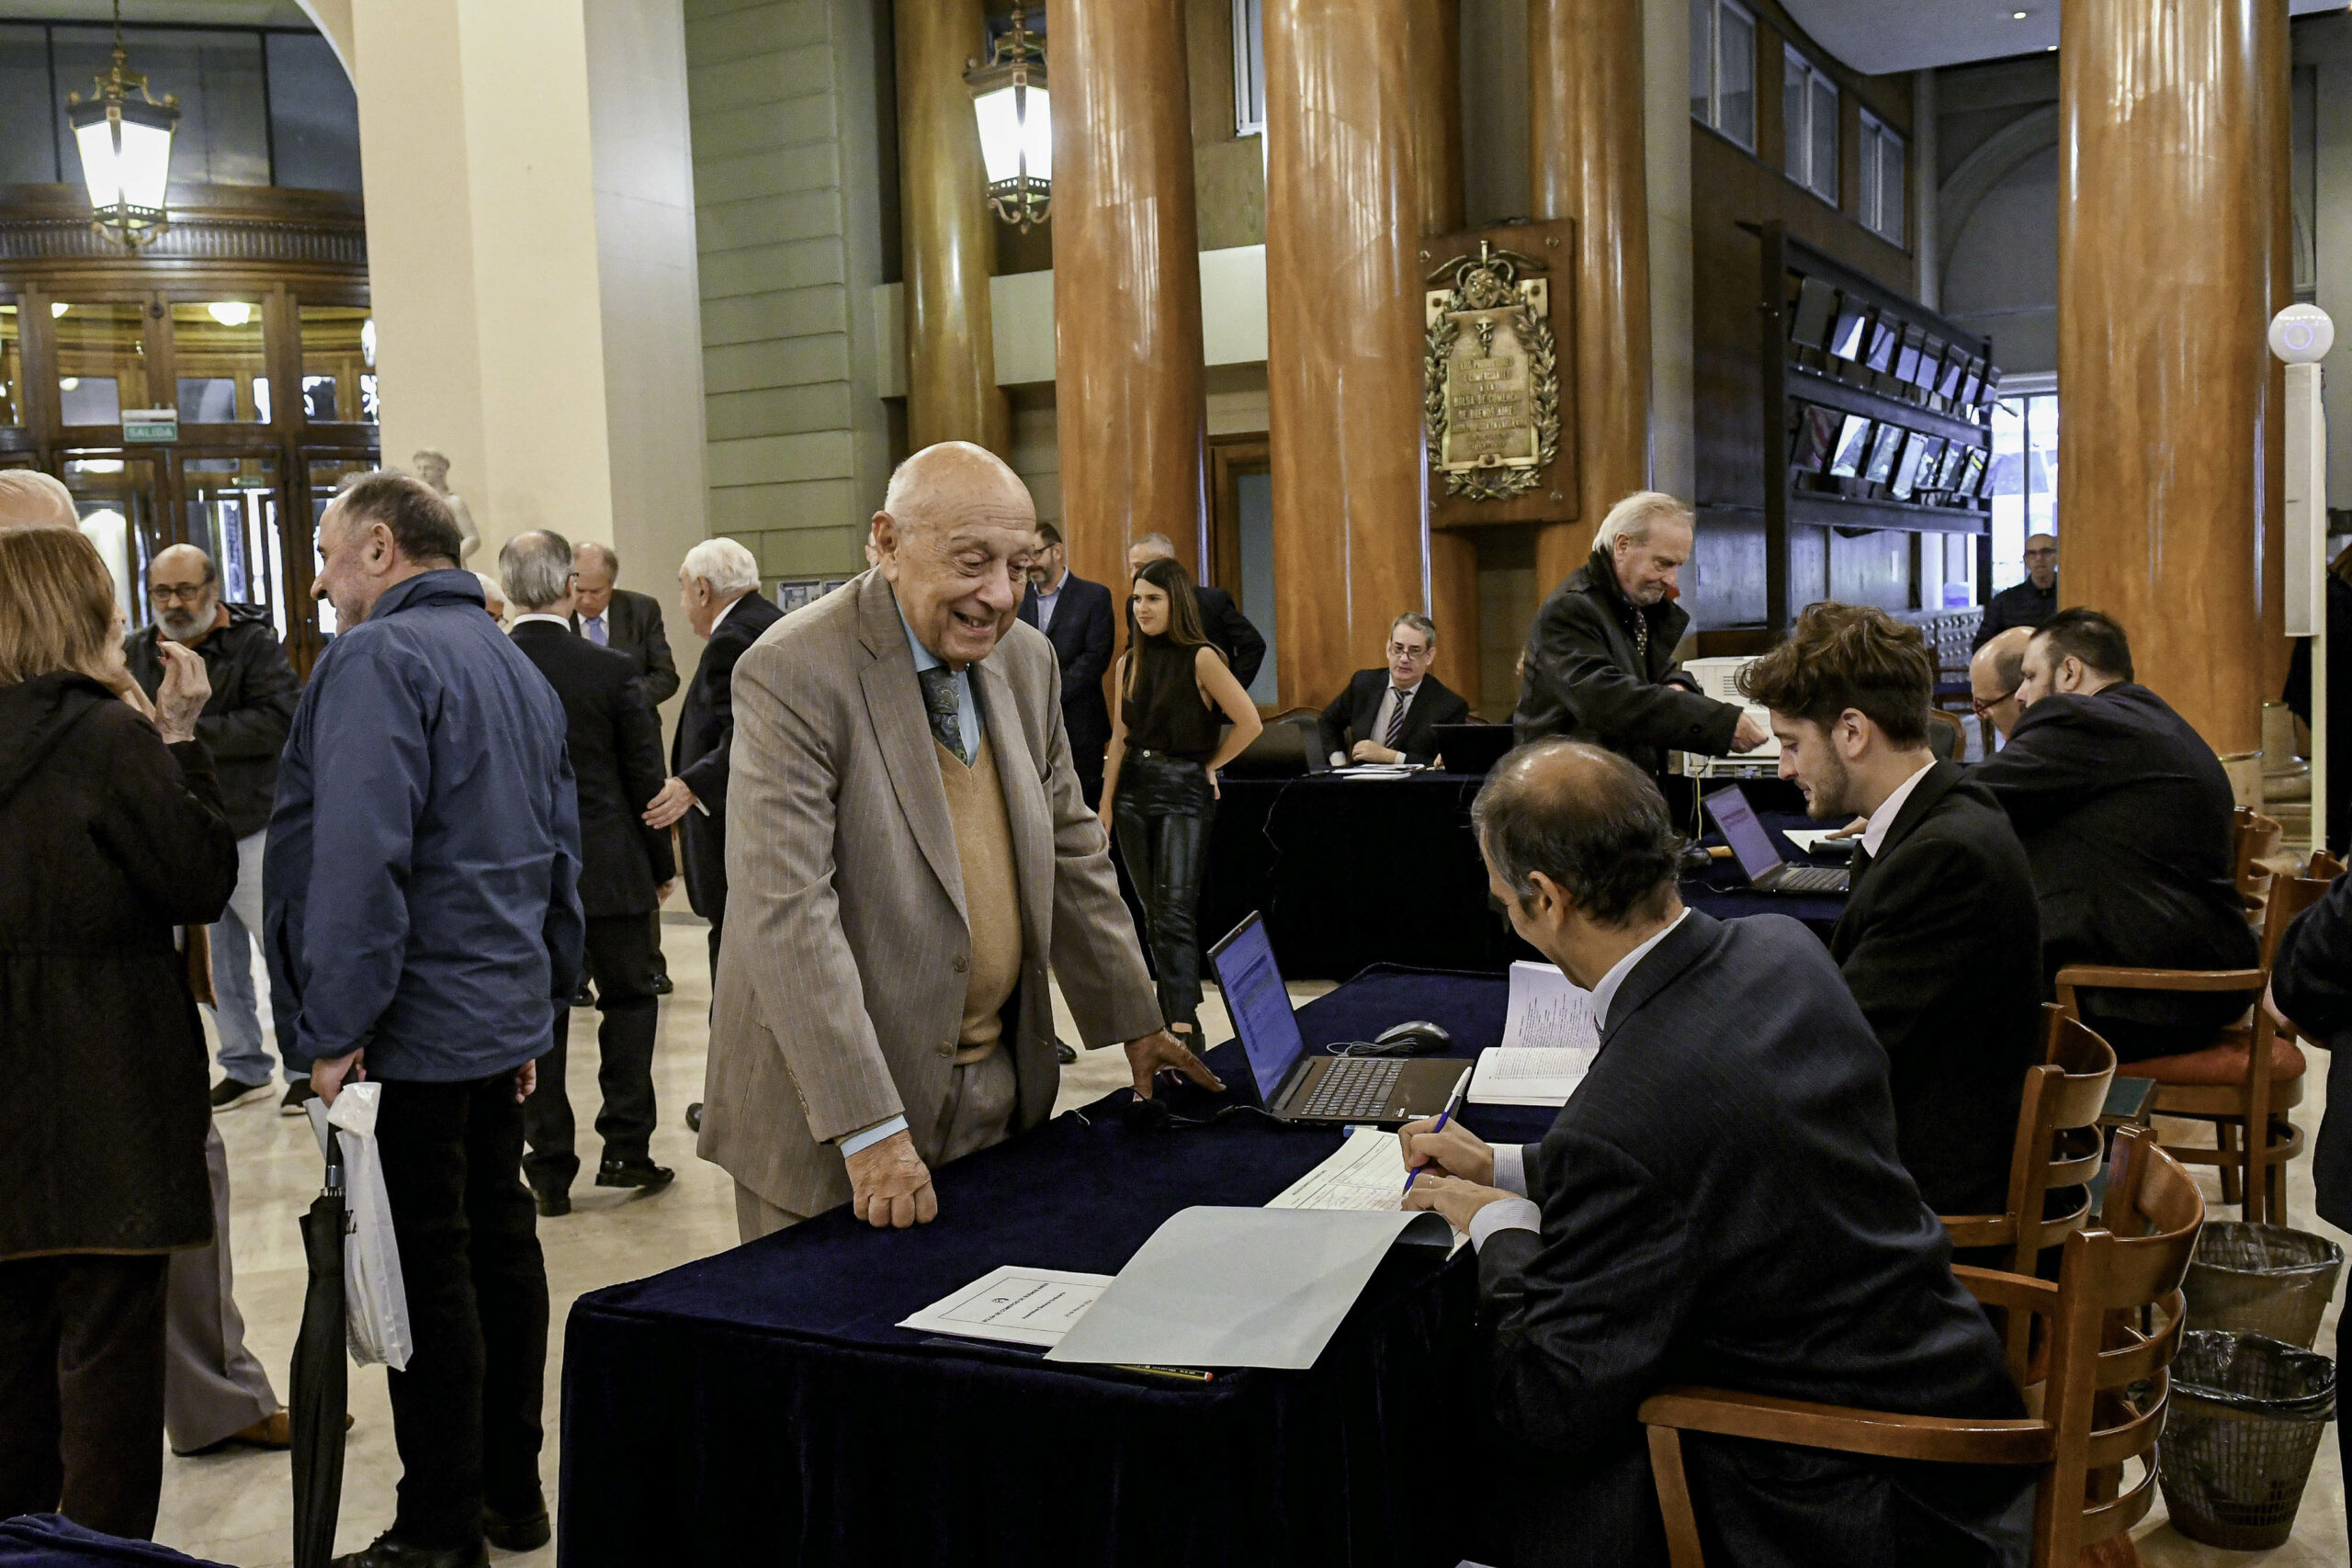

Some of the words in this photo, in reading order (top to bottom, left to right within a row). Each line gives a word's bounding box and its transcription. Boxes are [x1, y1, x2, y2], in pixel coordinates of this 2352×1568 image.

[1453, 395, 1476, 406] BOLSA
[1477, 394, 1487, 404] DE
[1458, 410, 1467, 420] DE
[1470, 407, 1495, 418] BUENOS
[128, 425, 175, 439] SALIDA
